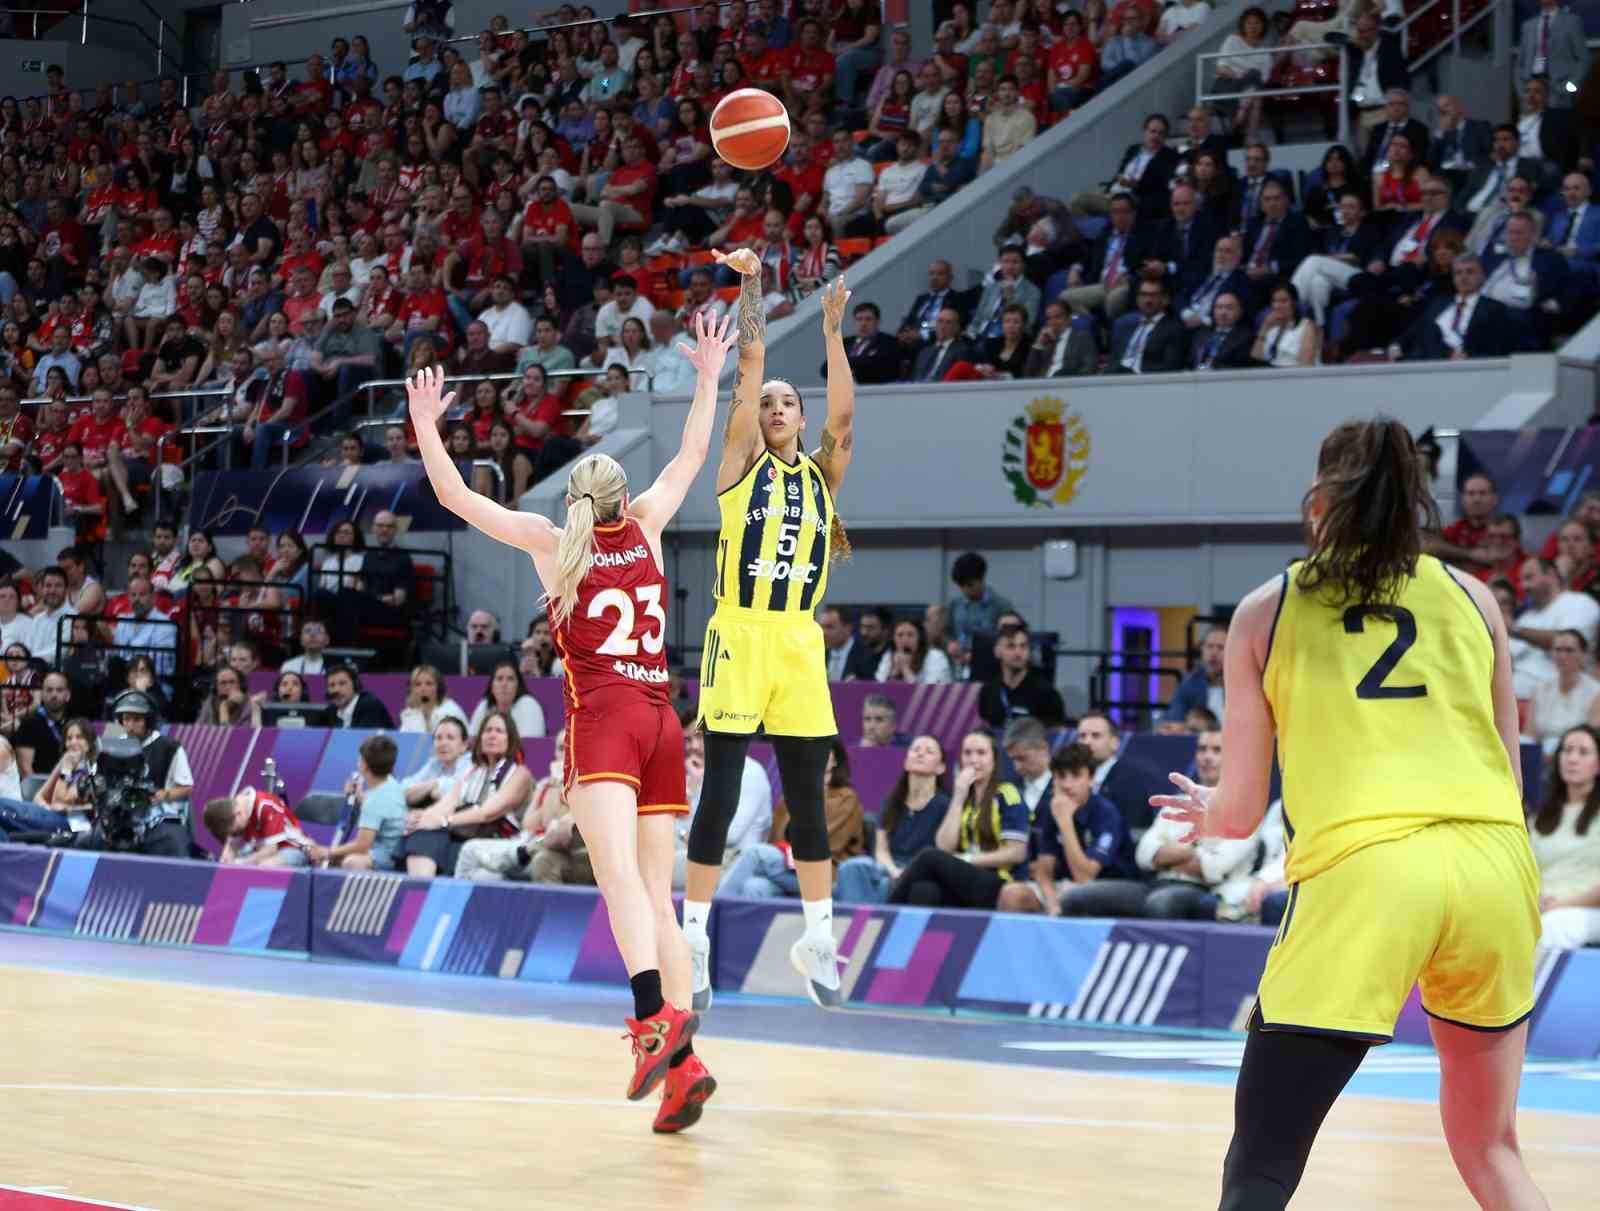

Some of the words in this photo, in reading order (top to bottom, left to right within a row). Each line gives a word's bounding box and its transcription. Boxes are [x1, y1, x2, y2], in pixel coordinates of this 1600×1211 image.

[778, 523, 800, 556] 5
[587, 584, 666, 656] 23
[1344, 603, 1428, 699] 2
